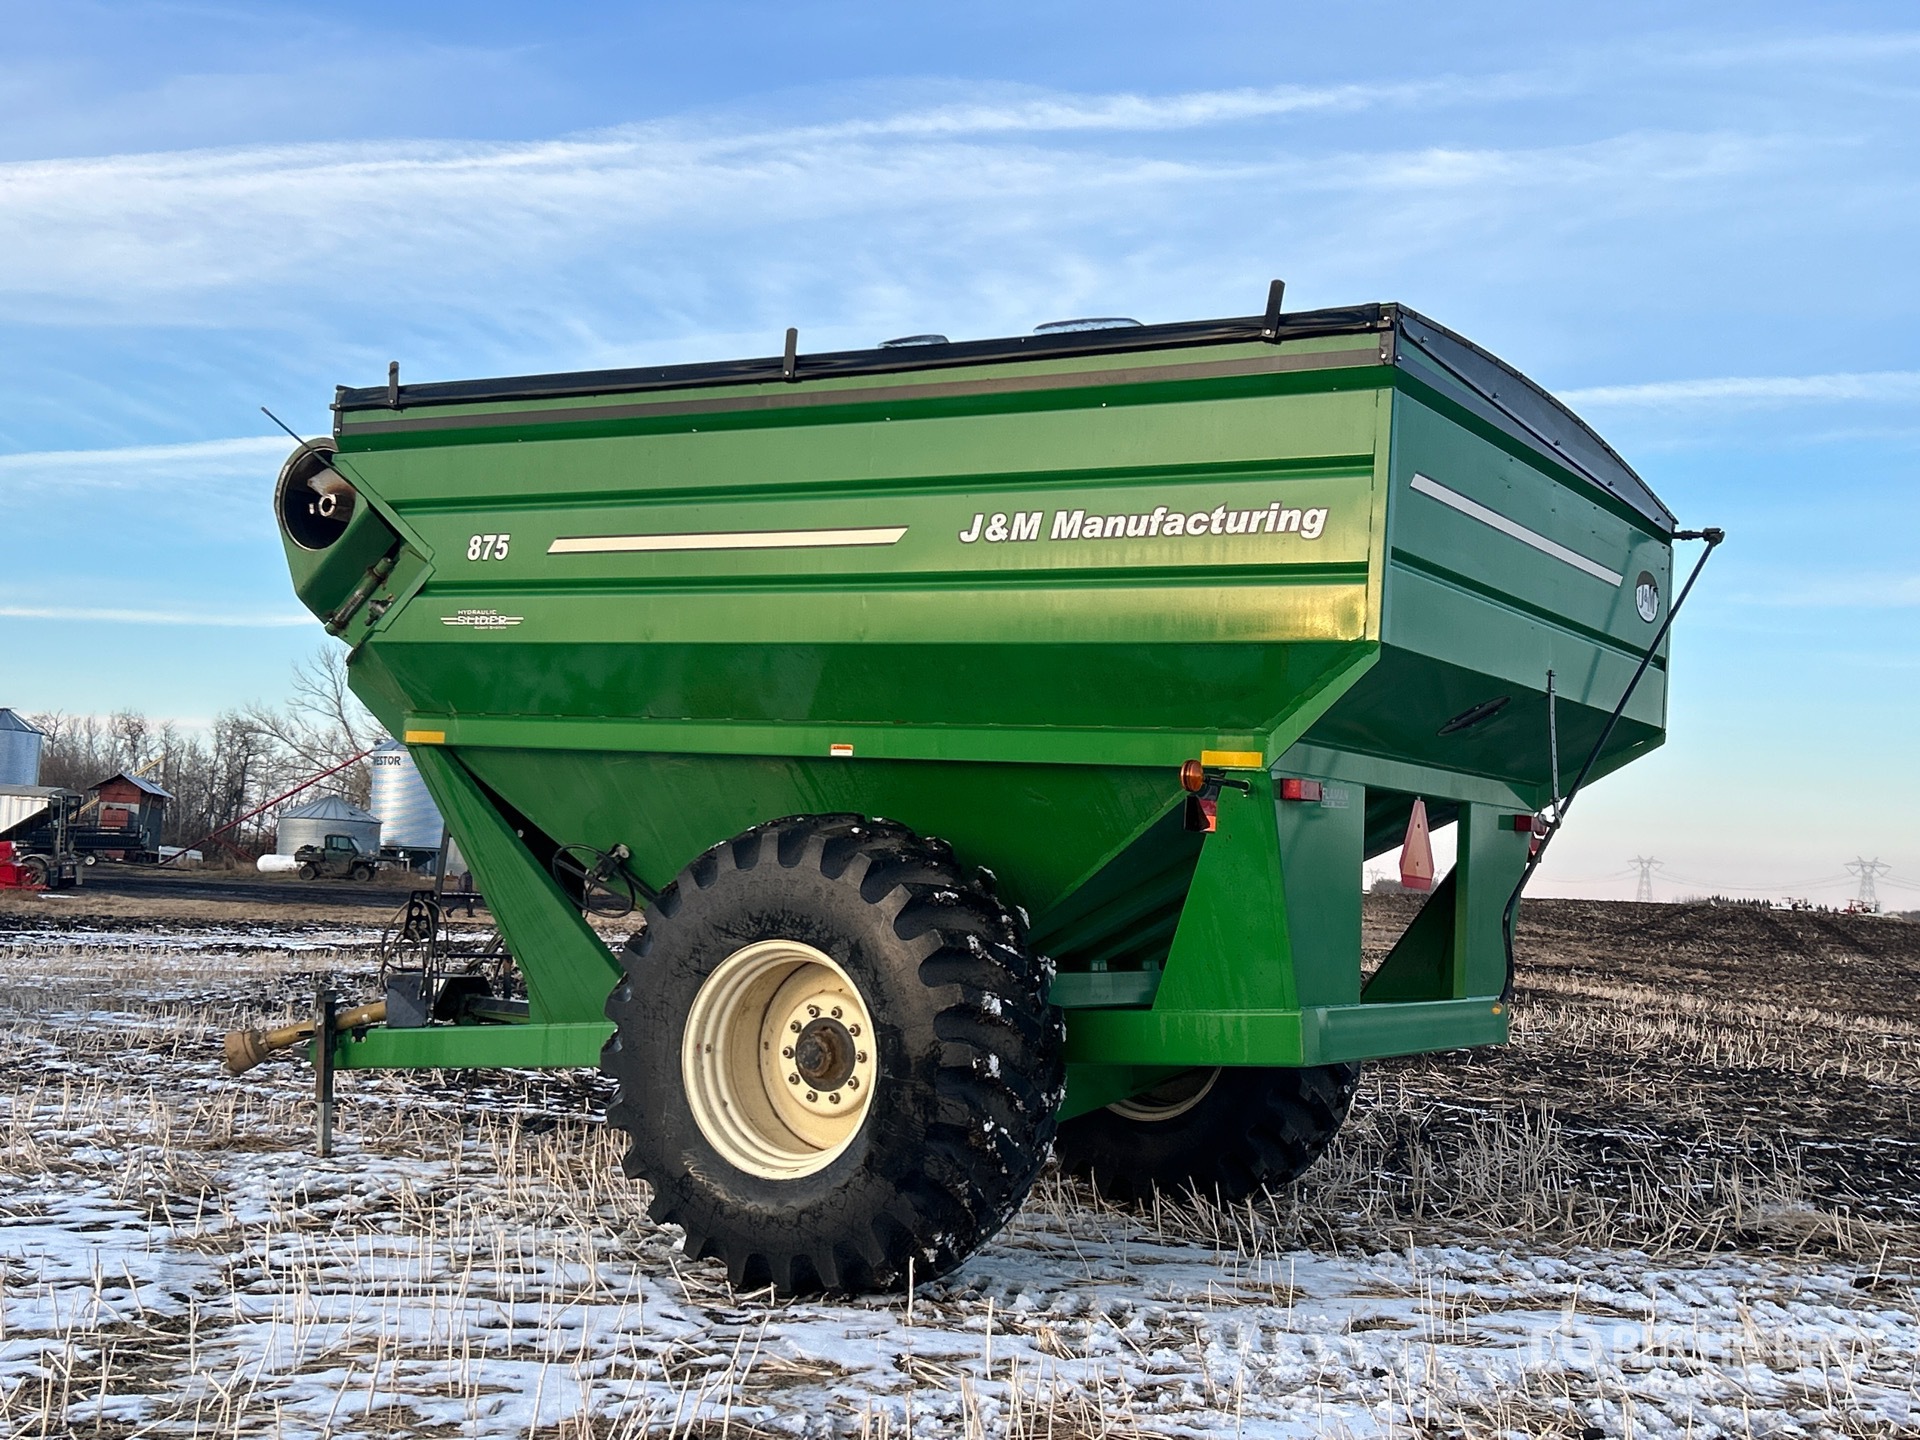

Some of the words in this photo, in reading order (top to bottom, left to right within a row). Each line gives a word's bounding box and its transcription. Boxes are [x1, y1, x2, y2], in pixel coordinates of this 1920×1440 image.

[959, 512, 1043, 543] J&M
[1049, 501, 1328, 540] Manufacturing
[467, 533, 511, 561] 875
[457, 615, 507, 626] SLIDER
